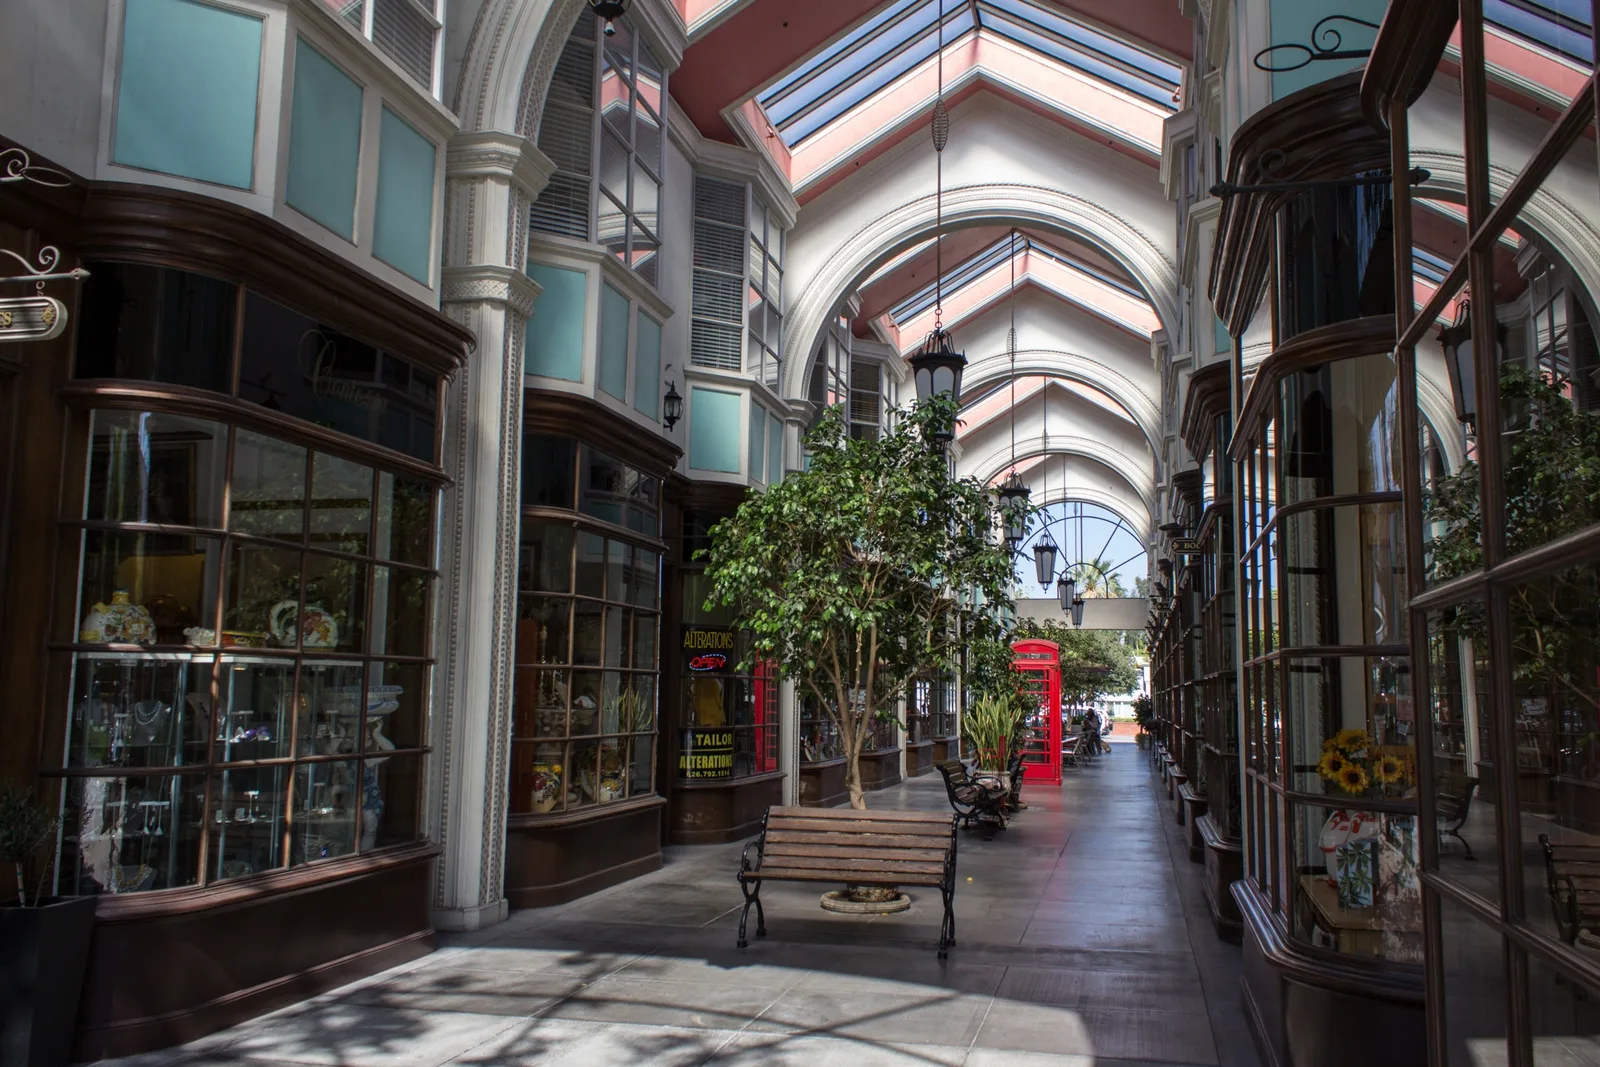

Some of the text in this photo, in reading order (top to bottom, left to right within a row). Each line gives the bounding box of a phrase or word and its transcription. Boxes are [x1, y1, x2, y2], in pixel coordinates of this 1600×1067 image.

[684, 631, 734, 649] ALTERATIONS
[691, 656, 726, 668] OPEN
[695, 733, 733, 746] TAILOR
[679, 754, 733, 769] ALTERATIONS
